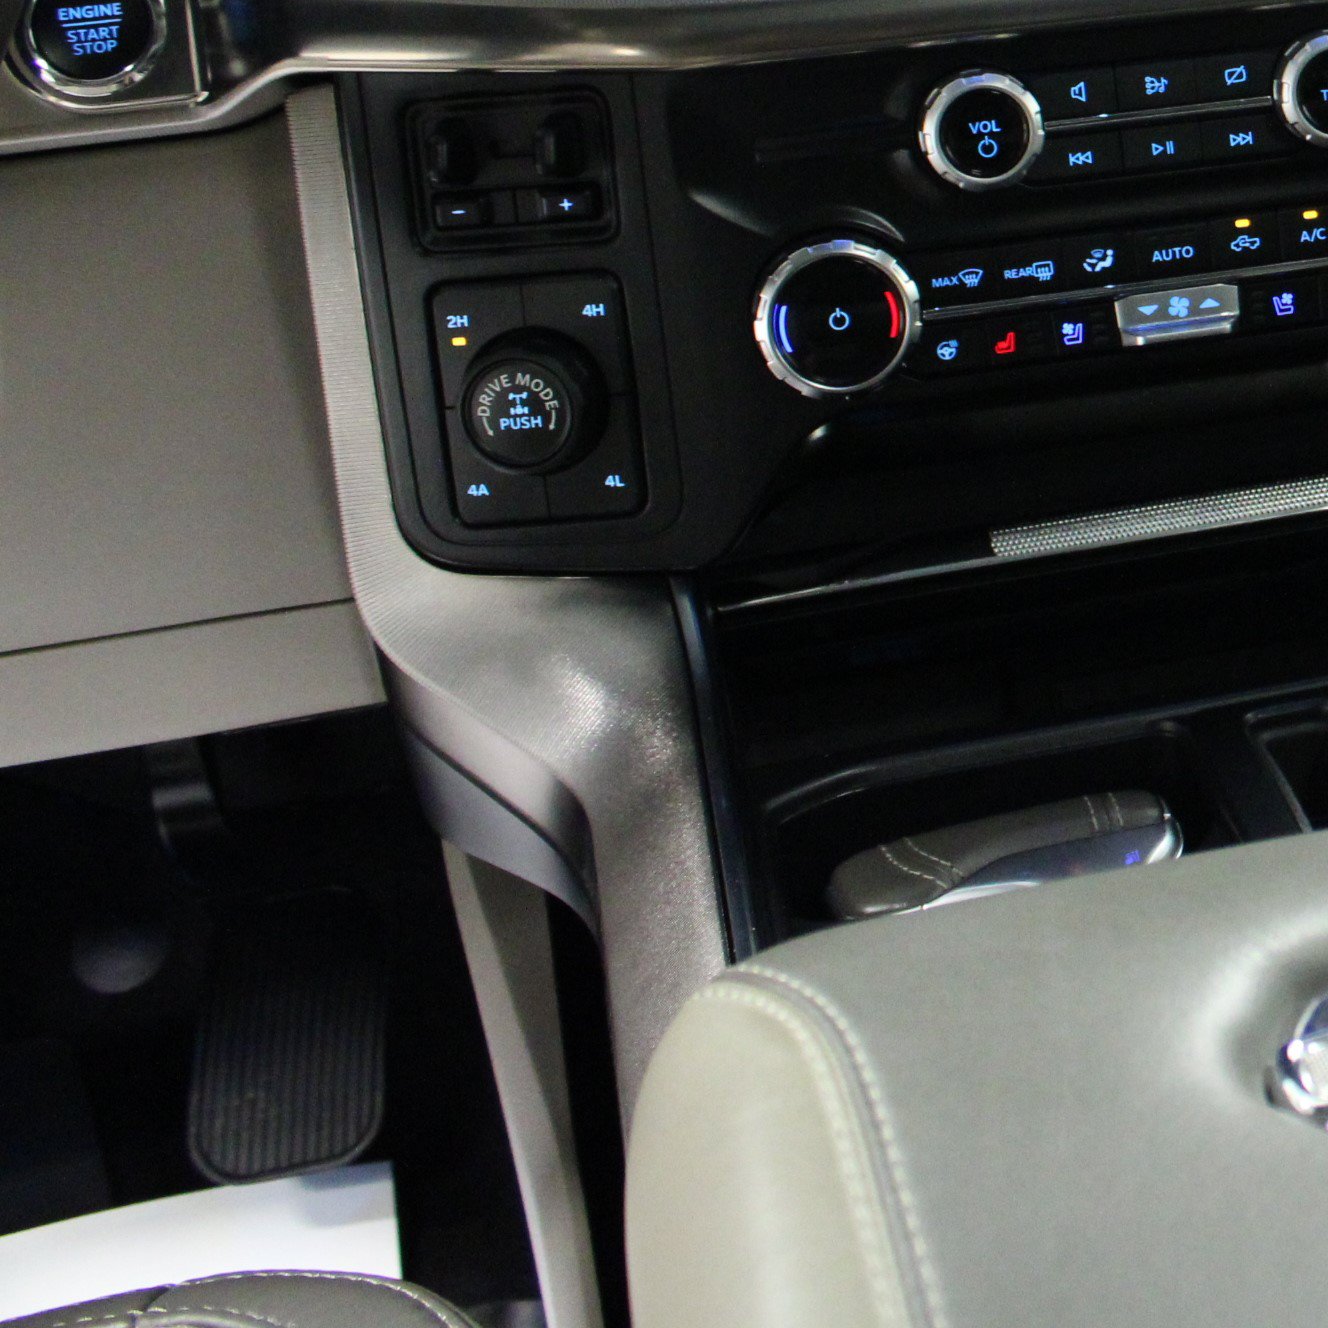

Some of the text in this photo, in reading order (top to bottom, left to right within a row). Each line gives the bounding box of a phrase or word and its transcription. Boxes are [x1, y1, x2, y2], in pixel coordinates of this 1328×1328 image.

[57, 2, 123, 21] ENGINE
[66, 26, 121, 43] START
[73, 40, 119, 56] STOP
[968, 119, 1002, 135] VOL
[1300, 227, 1328, 244] A/C
[1151, 245, 1195, 264] AUTO
[1003, 265, 1033, 280] REAR
[931, 274, 960, 289] MAX
[581, 302, 606, 318] 4H
[446, 314, 469, 329] 2H
[476, 371, 560, 418] DRIVE MODE
[499, 415, 543, 432] PUSH
[604, 473, 626, 489] 4L
[467, 482, 490, 498] 4A
